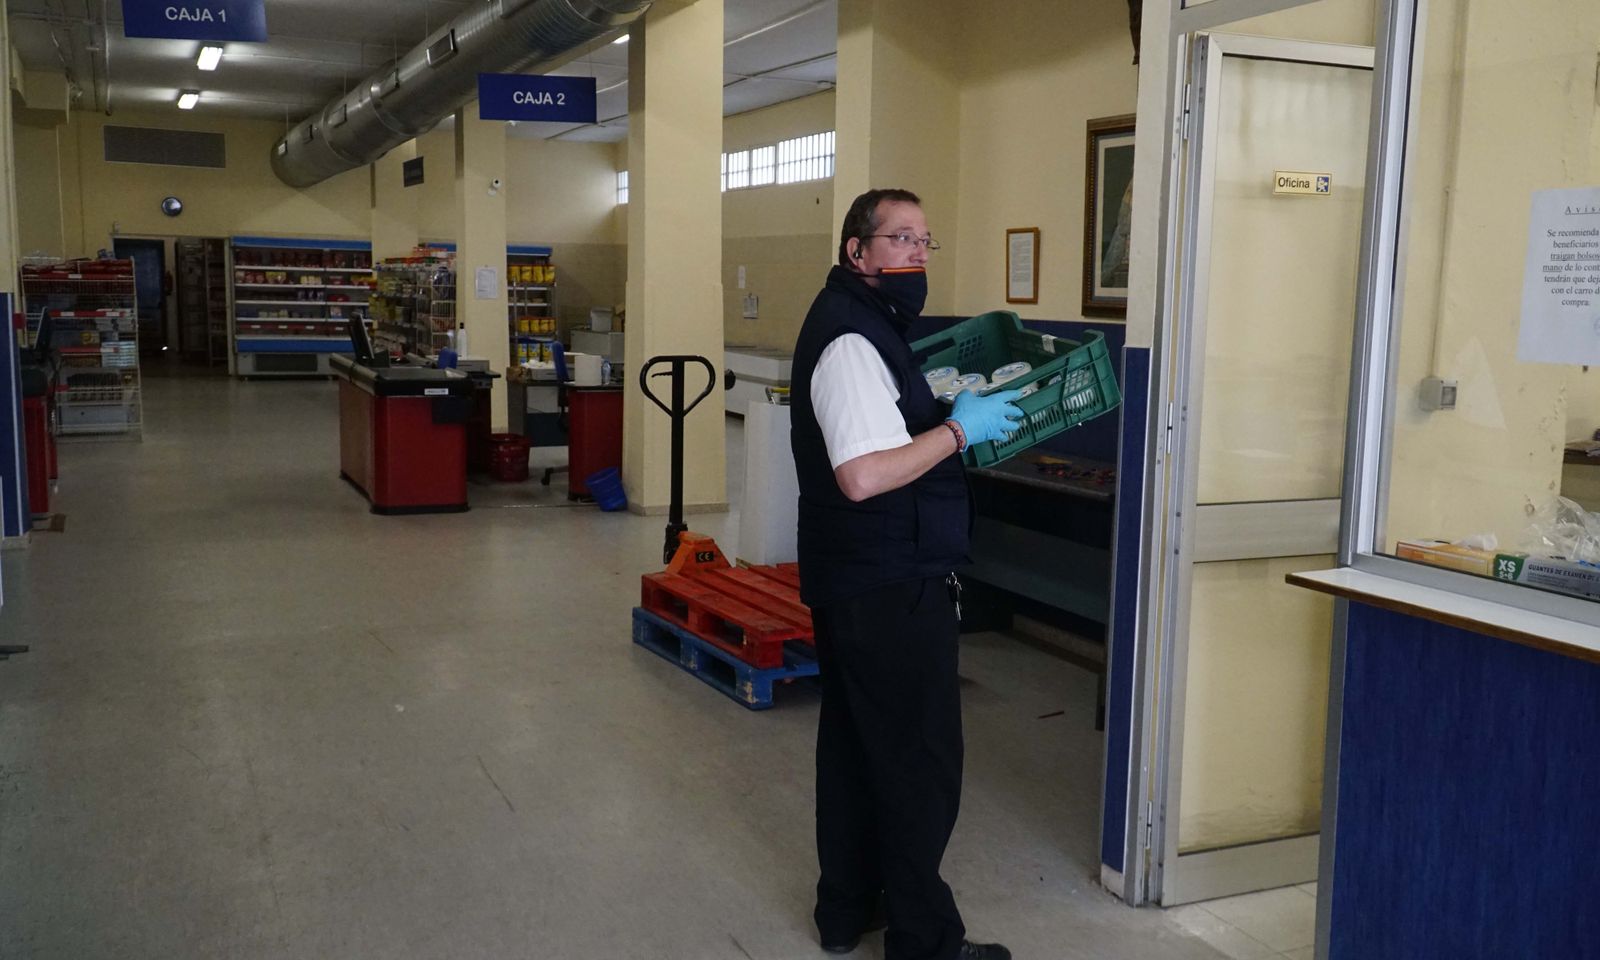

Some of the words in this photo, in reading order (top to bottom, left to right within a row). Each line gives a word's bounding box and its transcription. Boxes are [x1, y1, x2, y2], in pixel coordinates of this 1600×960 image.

[165, 6, 214, 22] CAJA
[218, 9, 227, 23] 1
[512, 91, 553, 105] CAJA
[556, 92, 566, 105] 2
[1278, 176, 1310, 189] Oficina
[1547, 229, 1557, 237] Se
[1558, 228, 1599, 236] recomienda
[1553, 240, 1599, 249] beneficiarios
[1550, 252, 1575, 261] traigan
[1564, 263, 1574, 271] de
[1575, 263, 1583, 271] lo
[1544, 274, 1571, 283] tendrán
[1572, 276, 1586, 285] que
[1566, 286, 1573, 294] el
[698, 552, 710, 561] CE
[1498, 558, 1517, 573] XS
[1528, 564, 1555, 574] GUANTES
